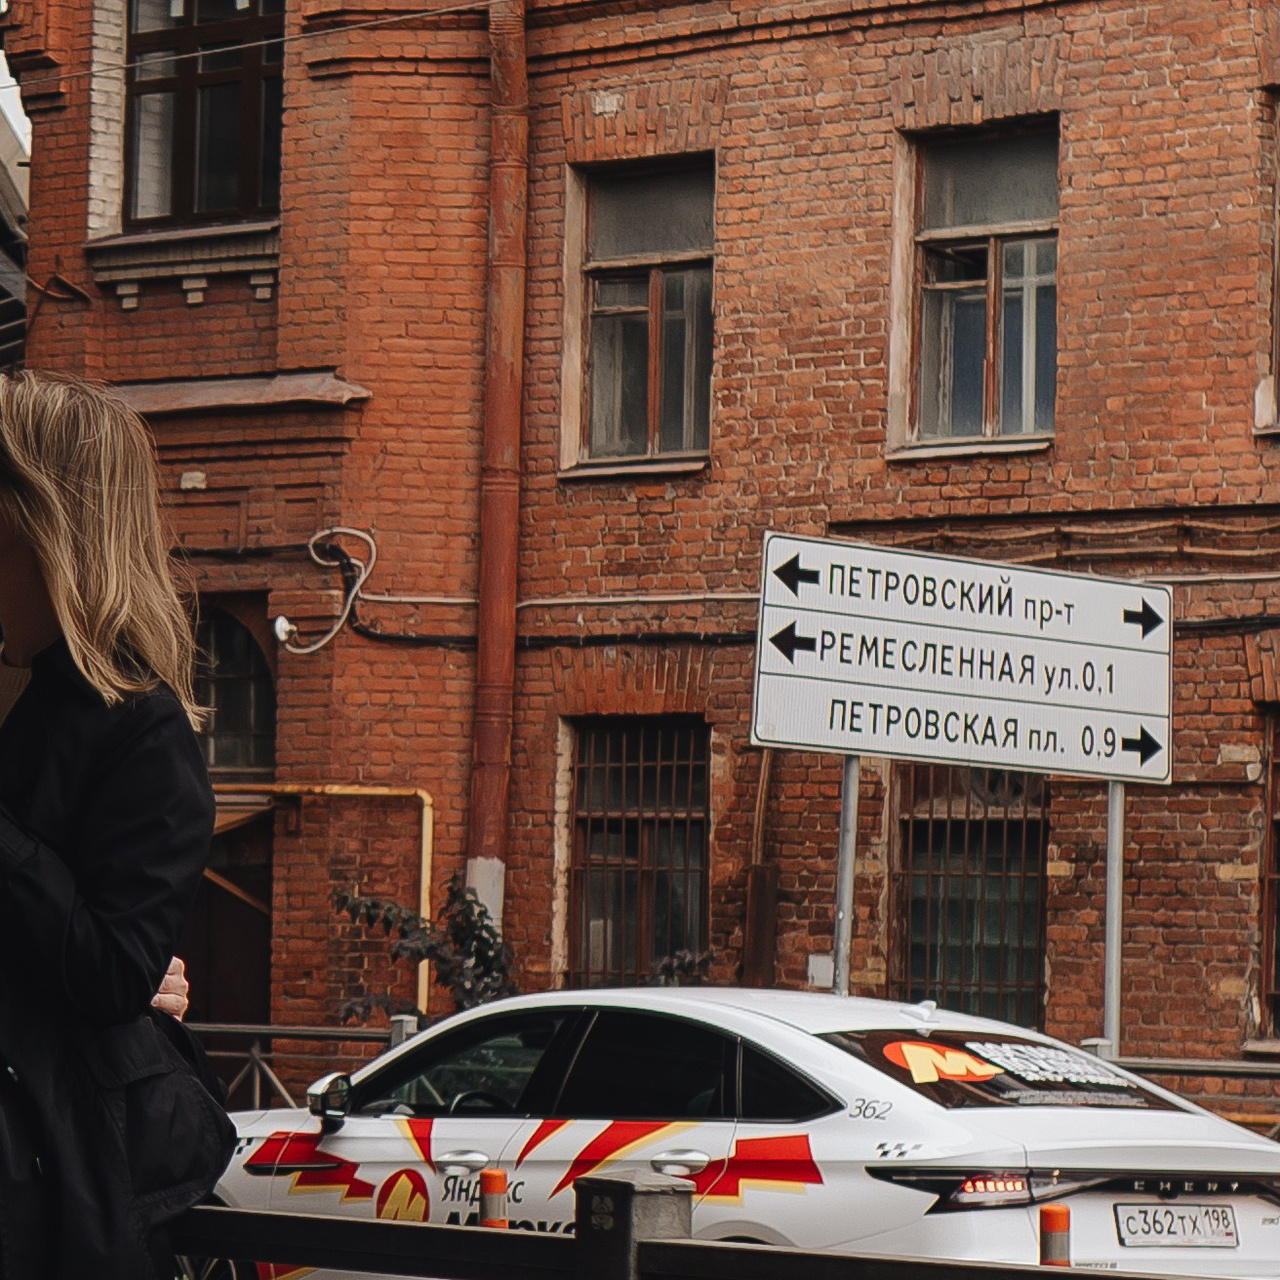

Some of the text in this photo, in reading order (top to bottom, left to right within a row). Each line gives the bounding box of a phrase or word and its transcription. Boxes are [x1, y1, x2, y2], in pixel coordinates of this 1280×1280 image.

[827, 563, 1075, 632] ПЕТРОВСКИЙ пр-т
[819, 630, 1035, 686] РЕМЕСЛЕННАЯ
[828, 698, 1019, 749] ПЕТРОВСКАЯ
[1028, 728, 1066, 754] пл.
[849, 1098, 894, 1120] 362
[441, 1175, 525, 1206] Яндс
[1203, 1209, 1231, 1229] 198
